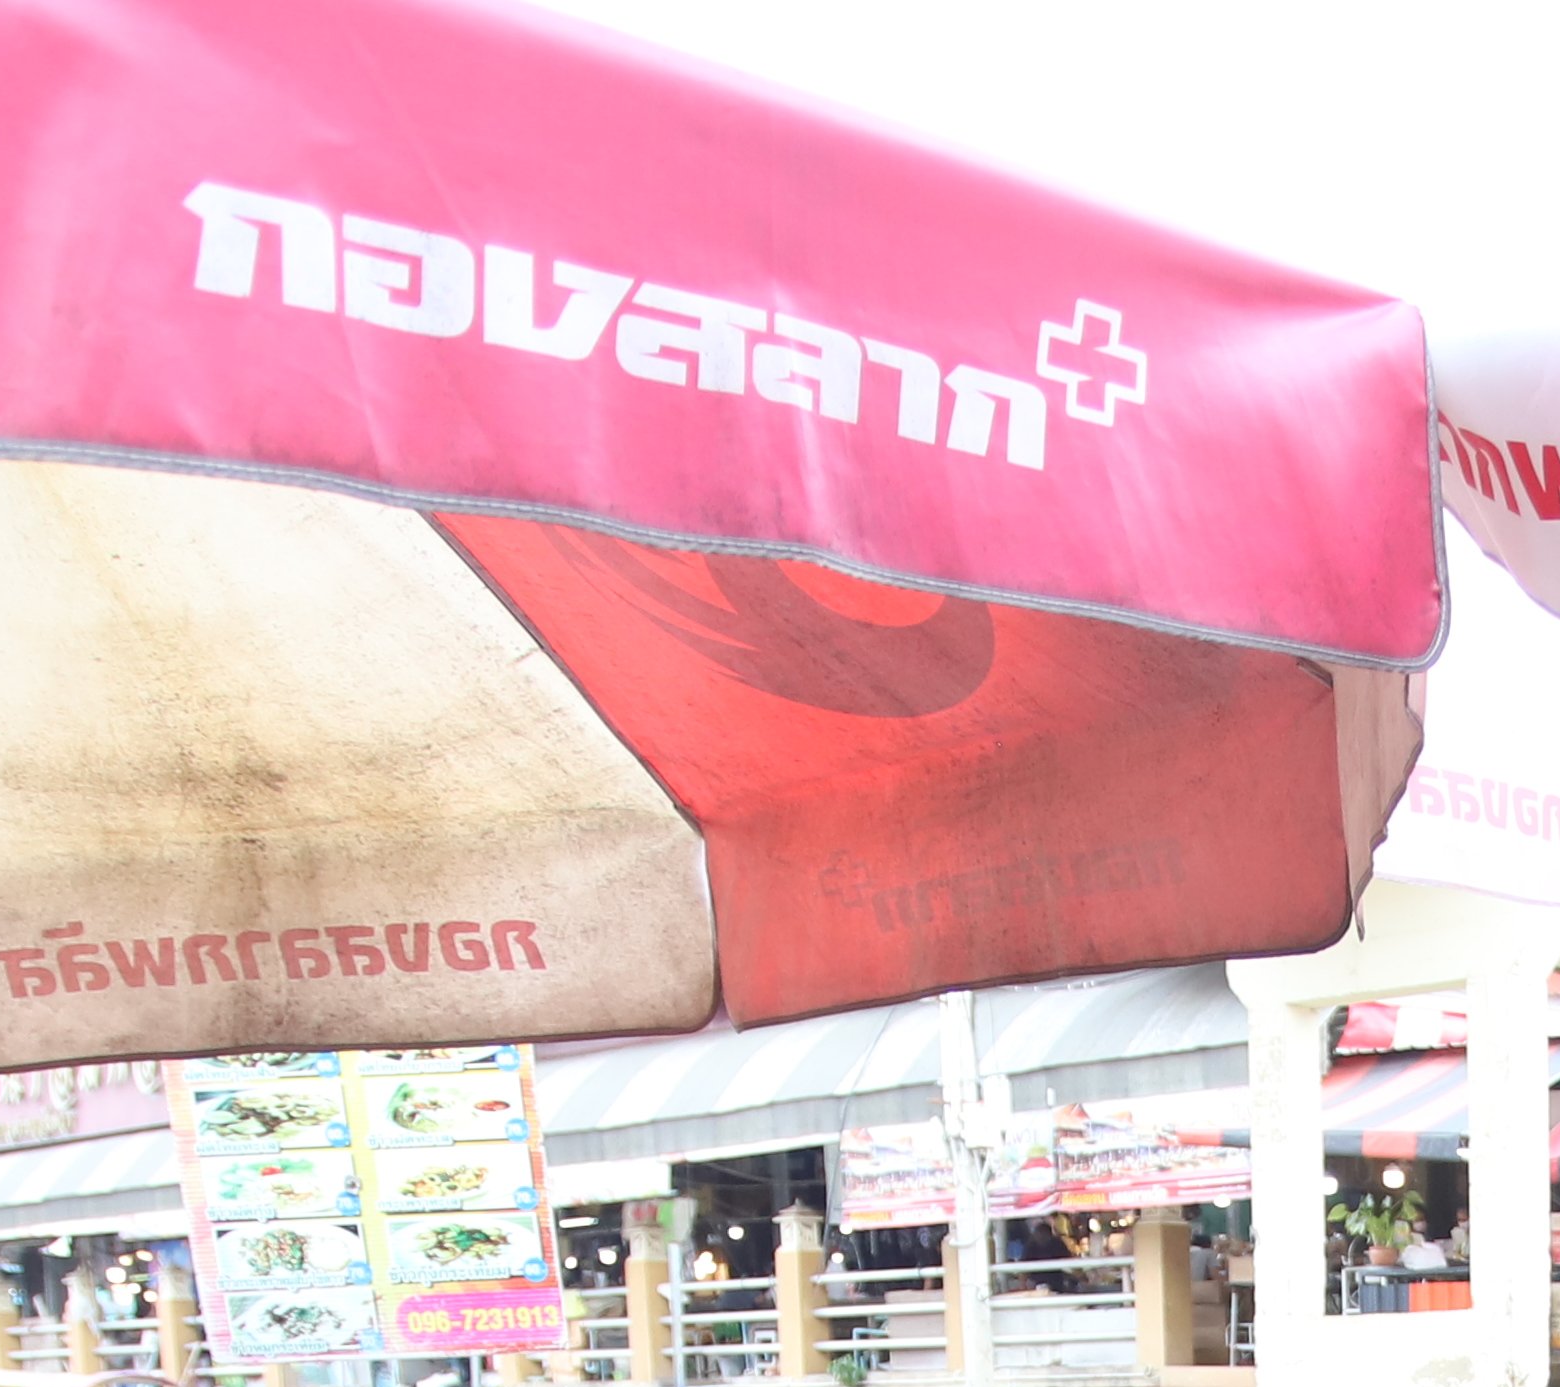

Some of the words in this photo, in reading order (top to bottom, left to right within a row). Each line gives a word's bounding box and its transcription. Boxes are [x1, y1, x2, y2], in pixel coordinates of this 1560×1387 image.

[183, 181, 1047, 470] กองสลาก
[407, 1304, 560, 1333] 096-7231913
